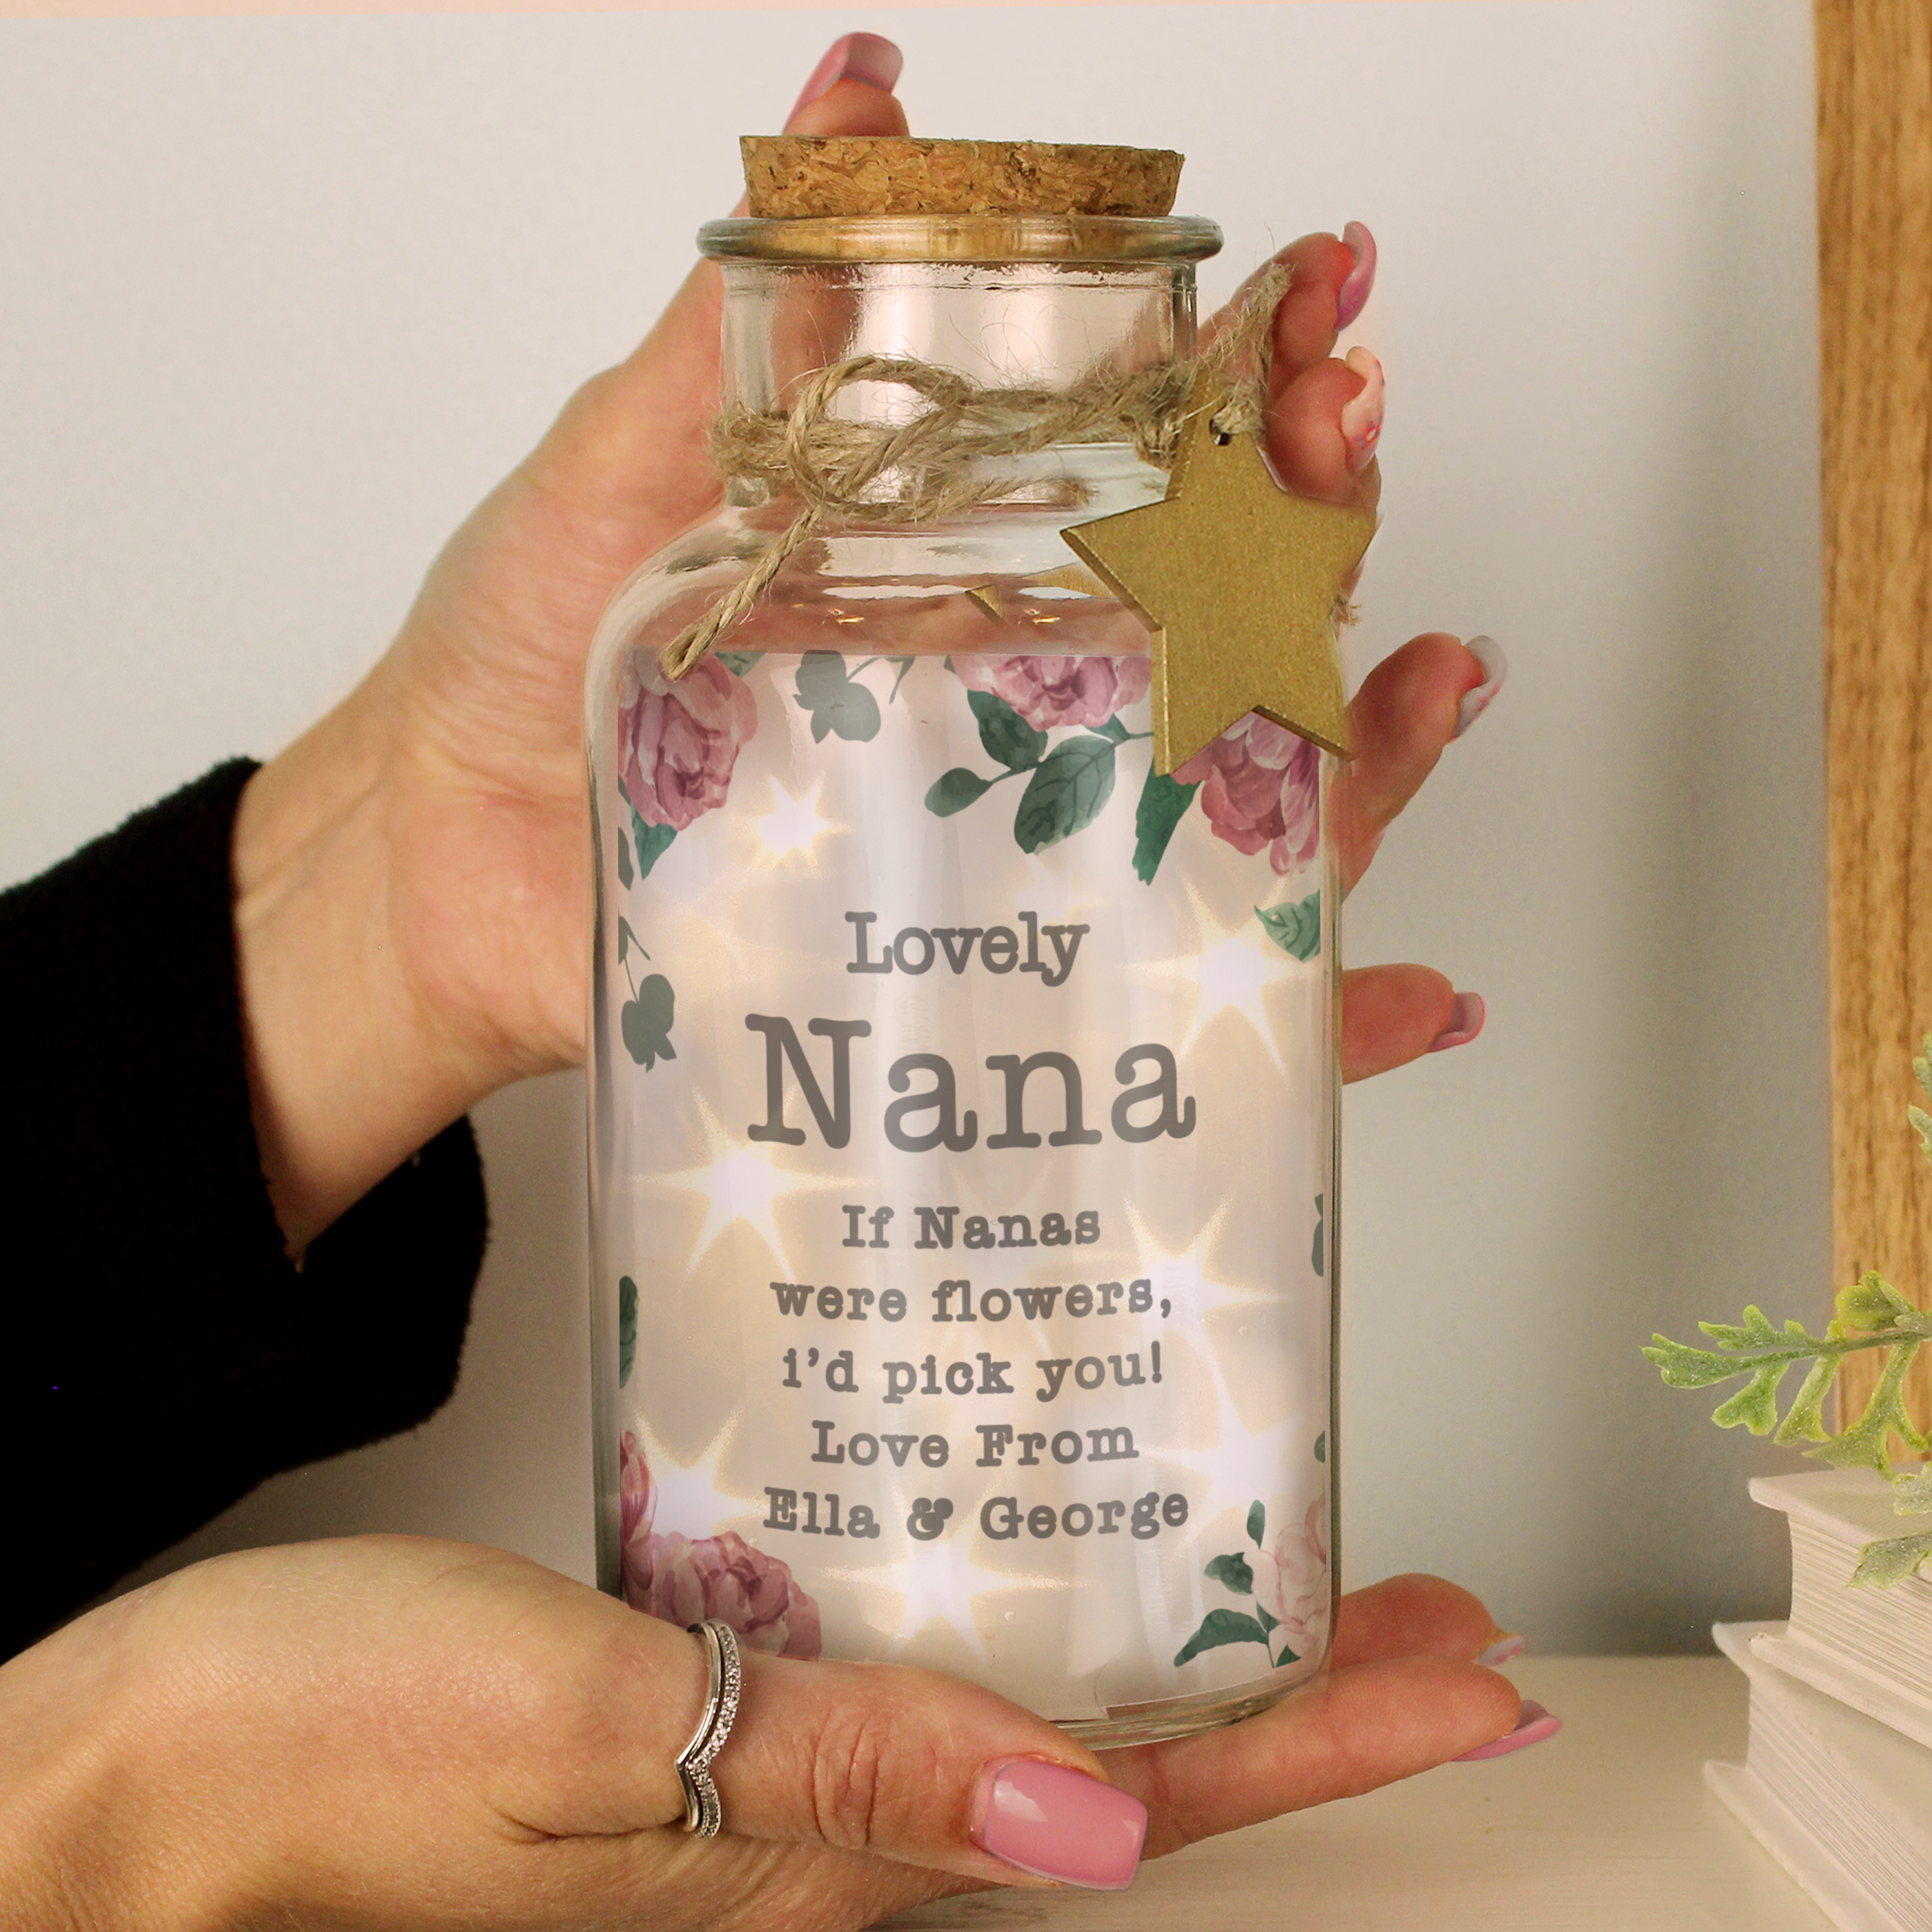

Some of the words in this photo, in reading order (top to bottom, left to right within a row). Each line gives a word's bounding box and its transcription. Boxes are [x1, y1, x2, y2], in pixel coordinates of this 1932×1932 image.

[845, 911, 1091, 987] Lovely
[745, 1013, 1196, 1152] Nana
[842, 1204, 894, 1248] If
[914, 1206, 1101, 1250] Nanas
[769, 1281, 907, 1322] were
[931, 1279, 1172, 1323] flowers,
[882, 1352, 1014, 1404] pick
[1036, 1340, 1163, 1403] you!
[811, 1419, 949, 1468] Love
[975, 1424, 1140, 1468] From
[762, 1486, 880, 1539] Ella
[907, 1497, 954, 1541] &
[980, 1491, 1189, 1541] George
